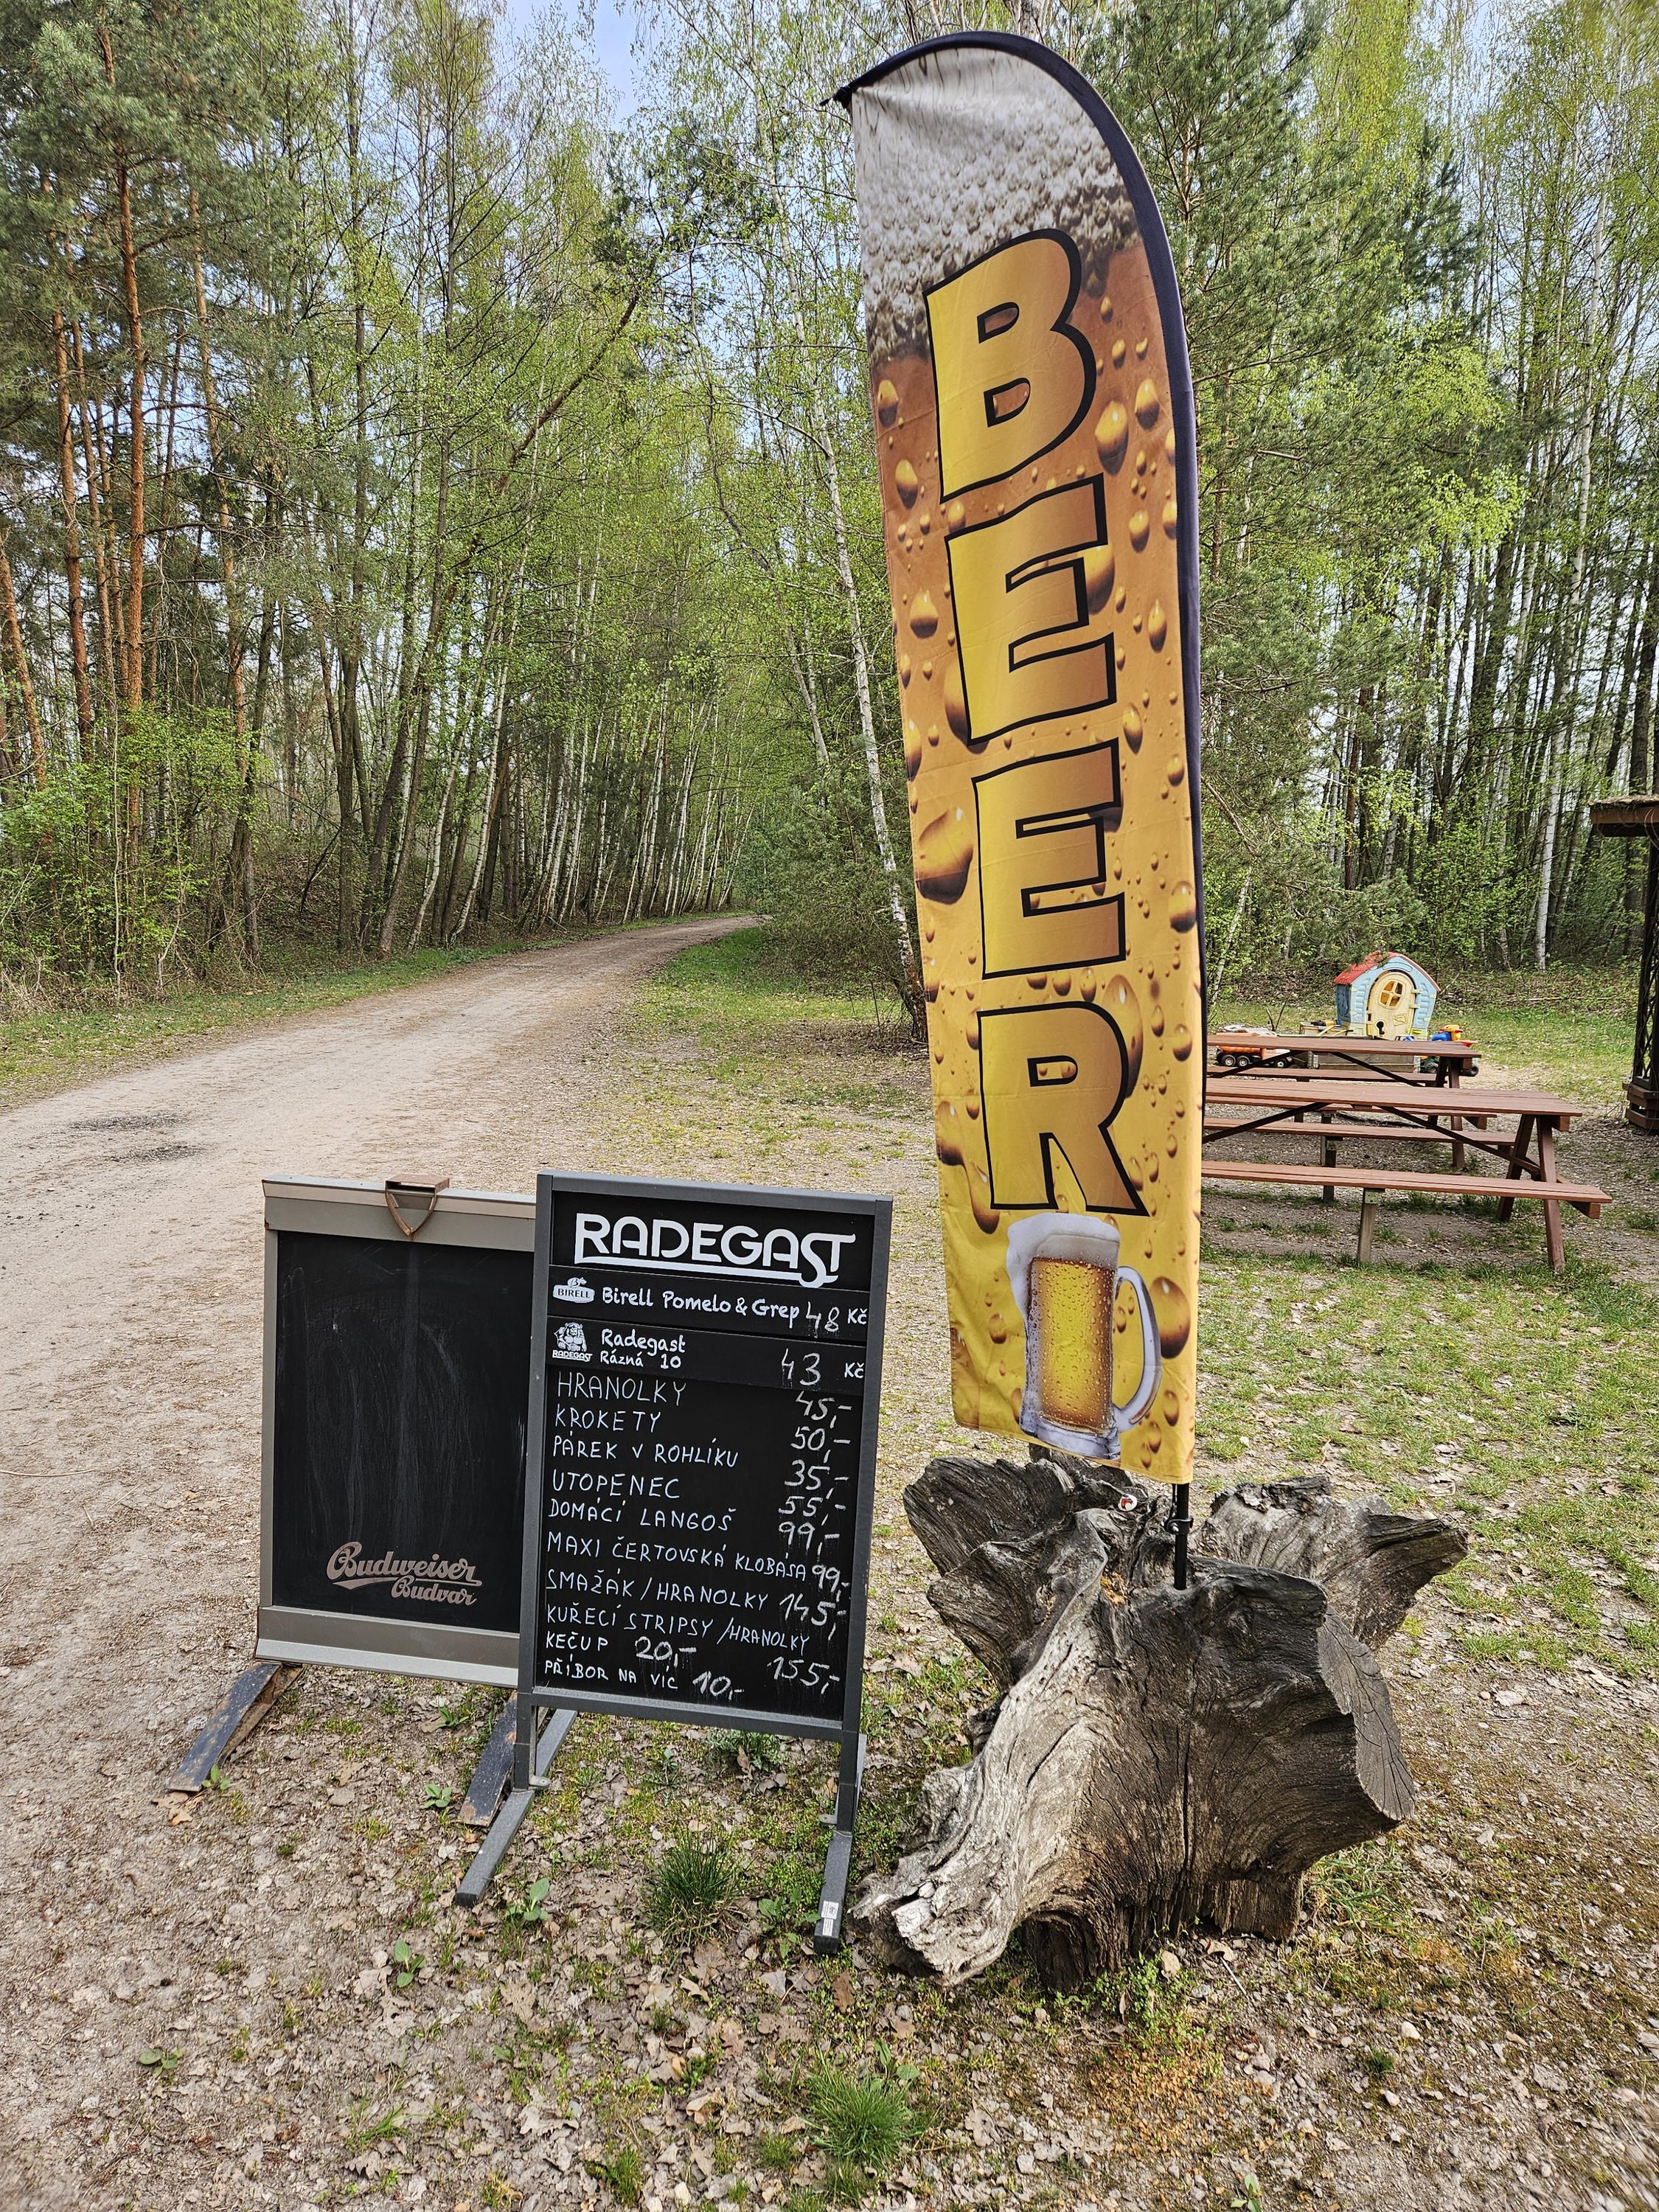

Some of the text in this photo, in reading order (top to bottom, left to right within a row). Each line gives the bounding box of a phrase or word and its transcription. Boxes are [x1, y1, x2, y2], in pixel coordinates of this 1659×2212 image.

[923, 228, 1150, 1217] BEER
[574, 1213, 855, 1288] RADEGAST
[557, 1288, 591, 1298] BIRELL
[602, 1287, 867, 1333] Birell Pomelo & Grep 48 Kč
[552, 1349, 593, 1362] RADEGAST
[600, 1349, 681, 1369] Rázná 10
[602, 1329, 865, 1386] Radegast 43 Kč
[557, 1371, 686, 1406] HRANOLKY
[554, 1404, 661, 1433] KROKETY
[552, 1430, 618, 1460] PÁREK
[655, 1438, 738, 1468] ROHLÍKU
[552, 1469, 681, 1499] UTOPENEC
[549, 1497, 626, 1523] DOMÁCÍ
[639, 1509, 737, 1532] LANGOŠ
[327, 1541, 482, 1588] Budweiser
[546, 1531, 600, 1558] MAXI
[612, 1536, 726, 1568] ČERTOVSKÁ
[735, 1552, 806, 1582] KLOBÁSA
[391, 1575, 478, 1606] Budvar
[546, 1602, 621, 1627] KUŘECÍ
[624, 1613, 714, 1638] STRIPSY
[546, 1630, 608, 1652] KEČUP
[544, 1653, 609, 1681] PŘÍBOR
[619, 1668, 637, 1683] NA
[650, 1664, 678, 1689] VÍC
